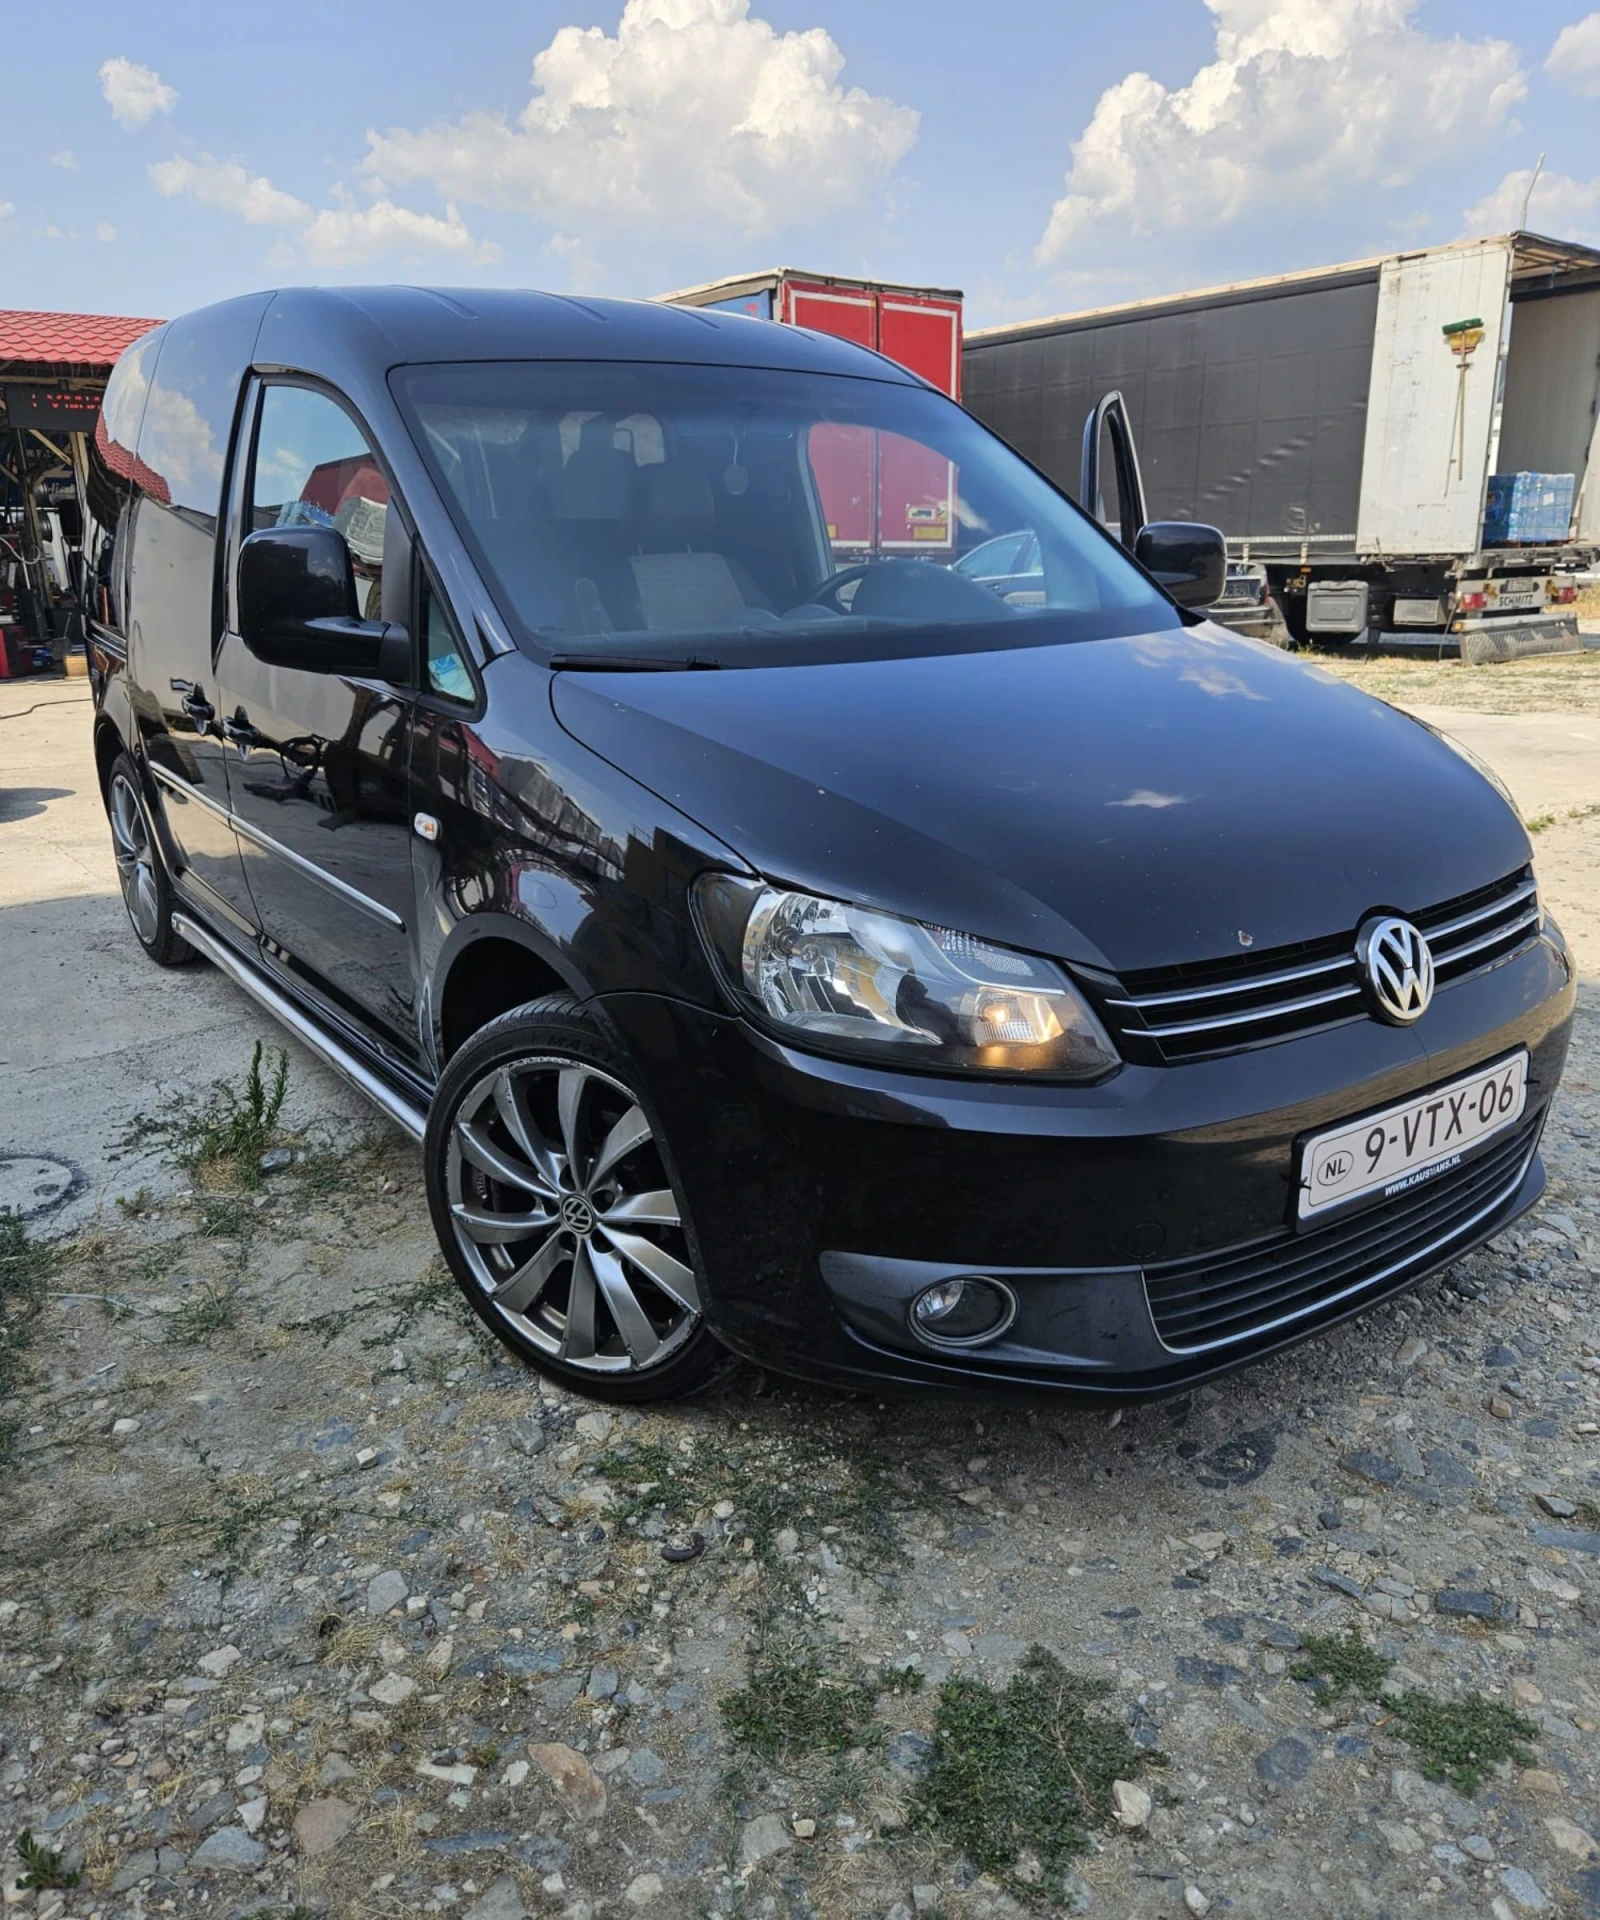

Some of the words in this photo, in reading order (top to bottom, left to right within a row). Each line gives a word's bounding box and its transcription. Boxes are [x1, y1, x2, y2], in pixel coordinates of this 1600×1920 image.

[1499, 594, 1533, 607] SCHMITZ
[1369, 919, 1433, 1019] VW
[1364, 1069, 1514, 1175] 9-VTX-06
[1325, 1159, 1346, 1179] NL
